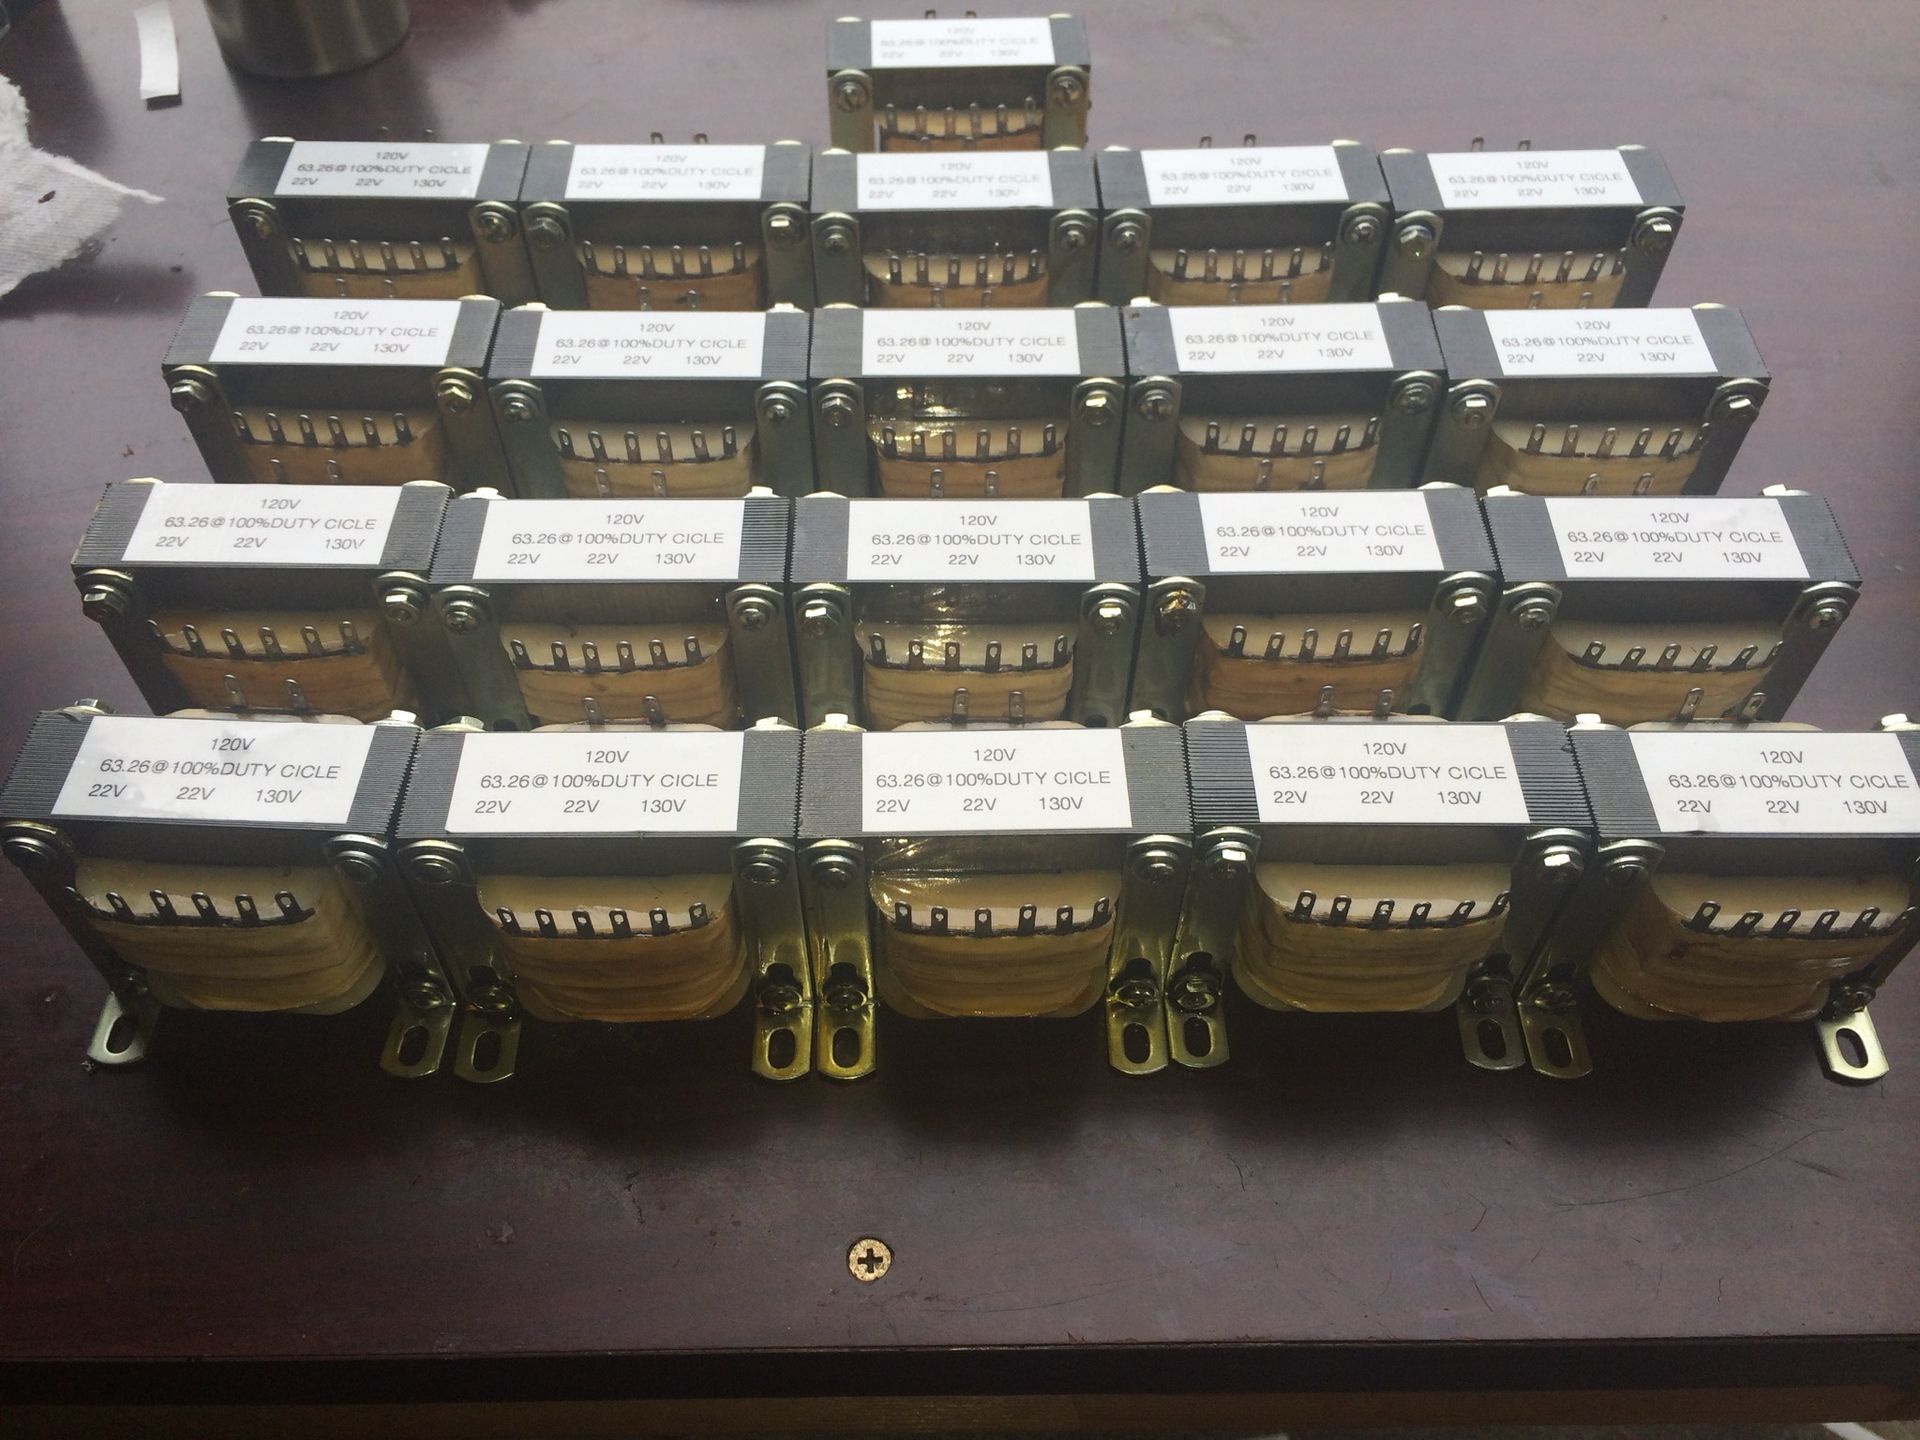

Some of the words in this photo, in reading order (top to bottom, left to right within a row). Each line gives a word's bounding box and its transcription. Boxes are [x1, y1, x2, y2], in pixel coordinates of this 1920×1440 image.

[376, 151, 409, 161] 120V
[428, 165, 472, 175] CICLE
[290, 176, 319, 186] 22V
[354, 177, 384, 187] 22V
[413, 178, 447, 188] 130V
[333, 310, 369, 321] 120V
[1260, 316, 1295, 327] 120V
[640, 322, 675, 333] 120V
[957, 321, 992, 332] 120V
[1575, 320, 1611, 331] 120V
[390, 327, 438, 338] CICLE
[1326, 330, 1373, 342] CICLE
[238, 340, 270, 351] 22V
[309, 341, 341, 352] 22V
[373, 343, 411, 354] 130V
[699, 339, 746, 350] CICLE
[1019, 336, 1065, 347] CICLE
[1645, 335, 1694, 346] CICLE
[552, 354, 582, 365] 22V
[622, 355, 653, 365] 22V
[686, 355, 722, 366] 130V
[876, 353, 906, 364] 22V
[946, 353, 975, 364] 22V
[1008, 353, 1044, 364] 130V
[1188, 350, 1216, 361] 22V
[1257, 348, 1285, 360] 22V
[1317, 347, 1354, 358] 130V
[1506, 353, 1535, 364] 22V
[1576, 352, 1605, 363] 22V
[1640, 351, 1676, 362] 130V
[261, 498, 302, 510] 120V
[1300, 506, 1339, 518] 120V
[1650, 512, 1690, 524] 120V
[164, 516, 321, 530] 63.26@100%DUTY
[323, 518, 377, 530] CICLE
[606, 513, 645, 526] 120V
[959, 514, 998, 527] 120V
[1216, 525, 1369, 538] 63.26@100%DUTY
[1374, 524, 1427, 537] CICLE
[1567, 531, 1723, 544] 63.26@100%DUTY
[1728, 531, 1784, 544] CICLE
[154, 535, 190, 548] 22V
[232, 536, 268, 549] 22V
[325, 538, 366, 551] 130V
[511, 532, 668, 545] 63.26@100%DUTY
[672, 532, 724, 545] CICLE
[871, 533, 1025, 546] 63.26@100%DUTY
[1029, 534, 1081, 546] CICLE
[1219, 545, 1251, 558] 22V
[1296, 545, 1328, 557] 22V
[1365, 544, 1404, 557] 130V
[1573, 551, 1605, 563] 22V
[1652, 551, 1683, 563] 22V
[1721, 551, 1762, 564] 130V
[506, 553, 541, 565] 22V
[586, 552, 620, 565] 22V
[655, 552, 696, 565] 130V
[870, 553, 903, 566] 22V
[948, 553, 980, 566] 22V
[1016, 553, 1056, 566] 130V
[211, 737, 256, 752] 120V
[1363, 742, 1407, 756] 120V
[586, 750, 630, 764] 120V
[974, 748, 1017, 762] 120V
[1759, 750, 1803, 765] 120V
[99, 758, 277, 777] 63.26@100%DUTY
[280, 764, 341, 780] CICLE
[1269, 765, 1441, 780] 63.26@100%DUTY
[1447, 766, 1508, 780] CICLE
[480, 773, 656, 789] 63.26@100%DUTY
[660, 773, 719, 788] CICLE
[875, 771, 1048, 789] 63.26@100%DUTY
[1053, 770, 1111, 786] CICLE
[1668, 773, 1842, 789] 63.26@100%DUTY
[1849, 774, 1910, 789] CICLE
[87, 783, 128, 798] 22V
[175, 786, 216, 801] 22V
[256, 789, 303, 804] 130V
[1273, 790, 1308, 804] 22V
[1360, 790, 1394, 805] 22V
[1437, 790, 1482, 805] 130V
[474, 800, 512, 814] 22V
[563, 799, 601, 814] 22V
[641, 799, 687, 814] 130V
[875, 799, 911, 813] 22V
[962, 797, 997, 812] 22V
[1039, 796, 1084, 811] 130V
[1676, 799, 1712, 814] 22V
[1765, 800, 1800, 814] 22V
[1842, 800, 1888, 815] 130V
